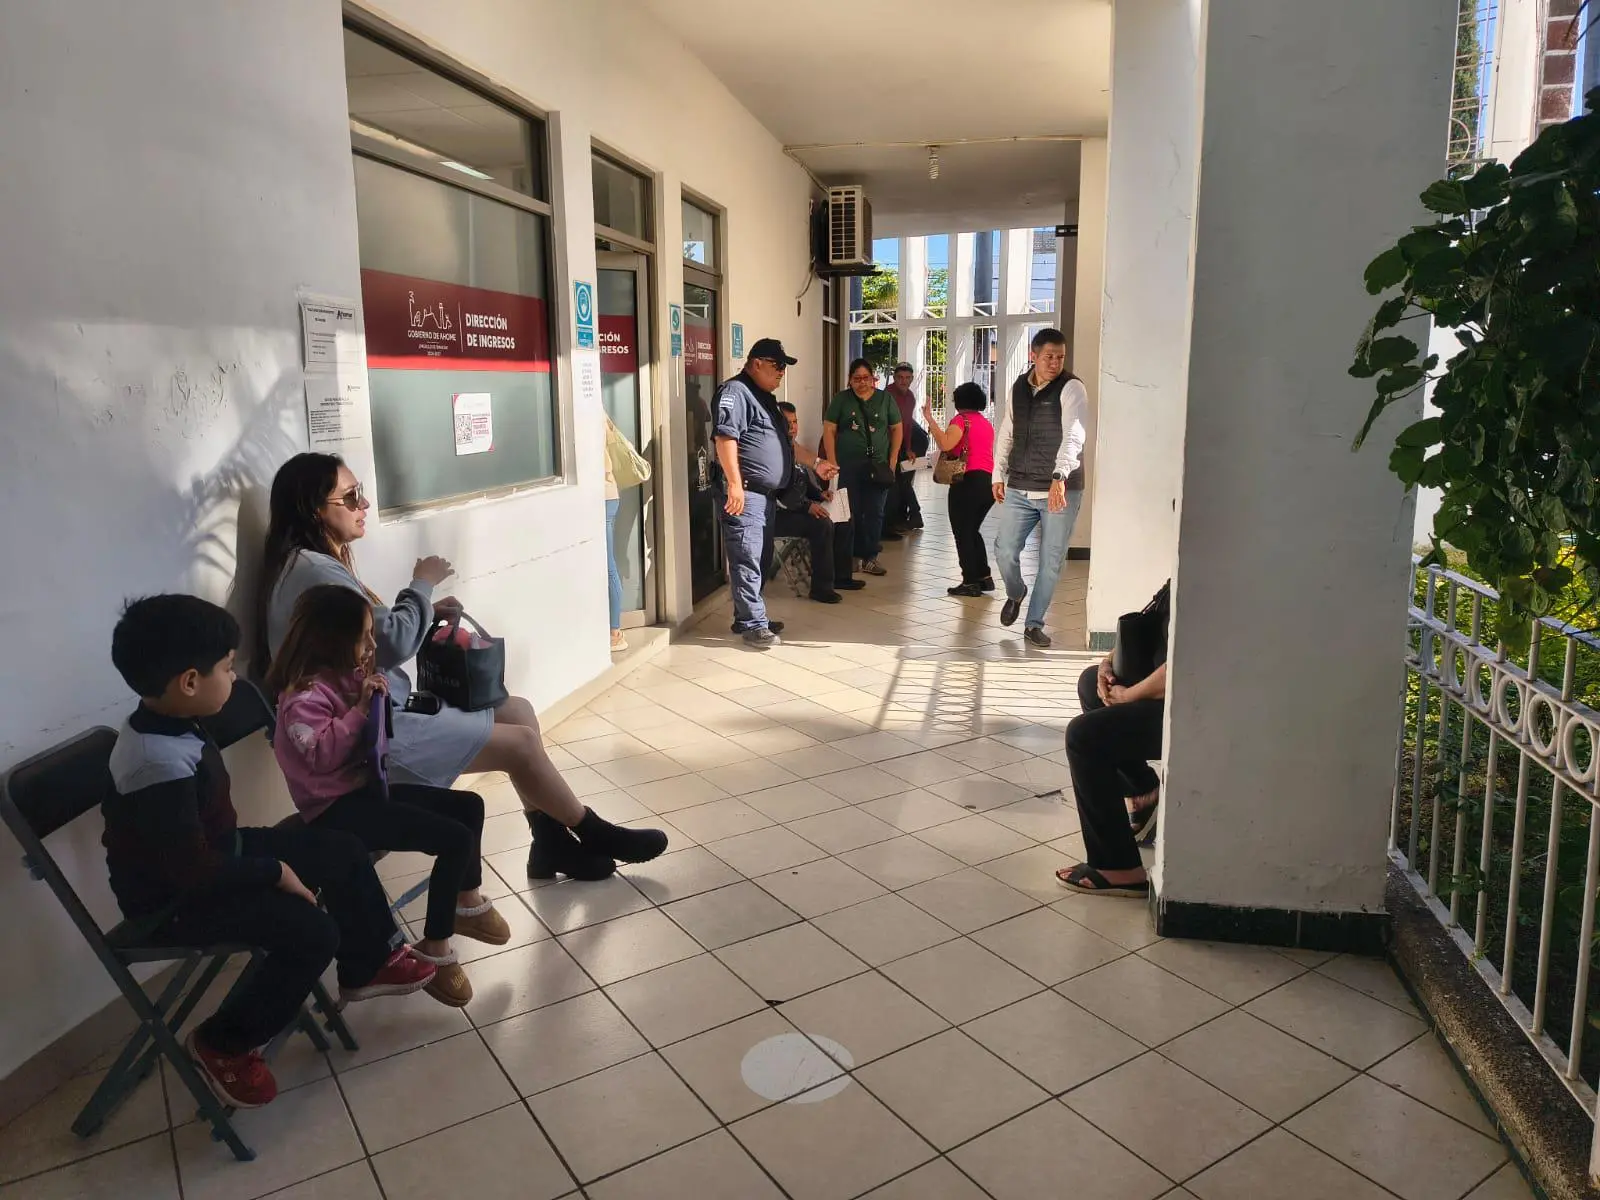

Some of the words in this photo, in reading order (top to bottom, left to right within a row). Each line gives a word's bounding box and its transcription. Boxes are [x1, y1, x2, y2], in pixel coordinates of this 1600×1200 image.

[465, 313, 508, 331] DIRECCIÓN
[407, 329, 433, 339] GOBIERNO
[433, 331, 439, 340] DE
[439, 332, 457, 342] AHOME
[466, 333, 478, 347] DE
[478, 334, 516, 349] INGRESOS
